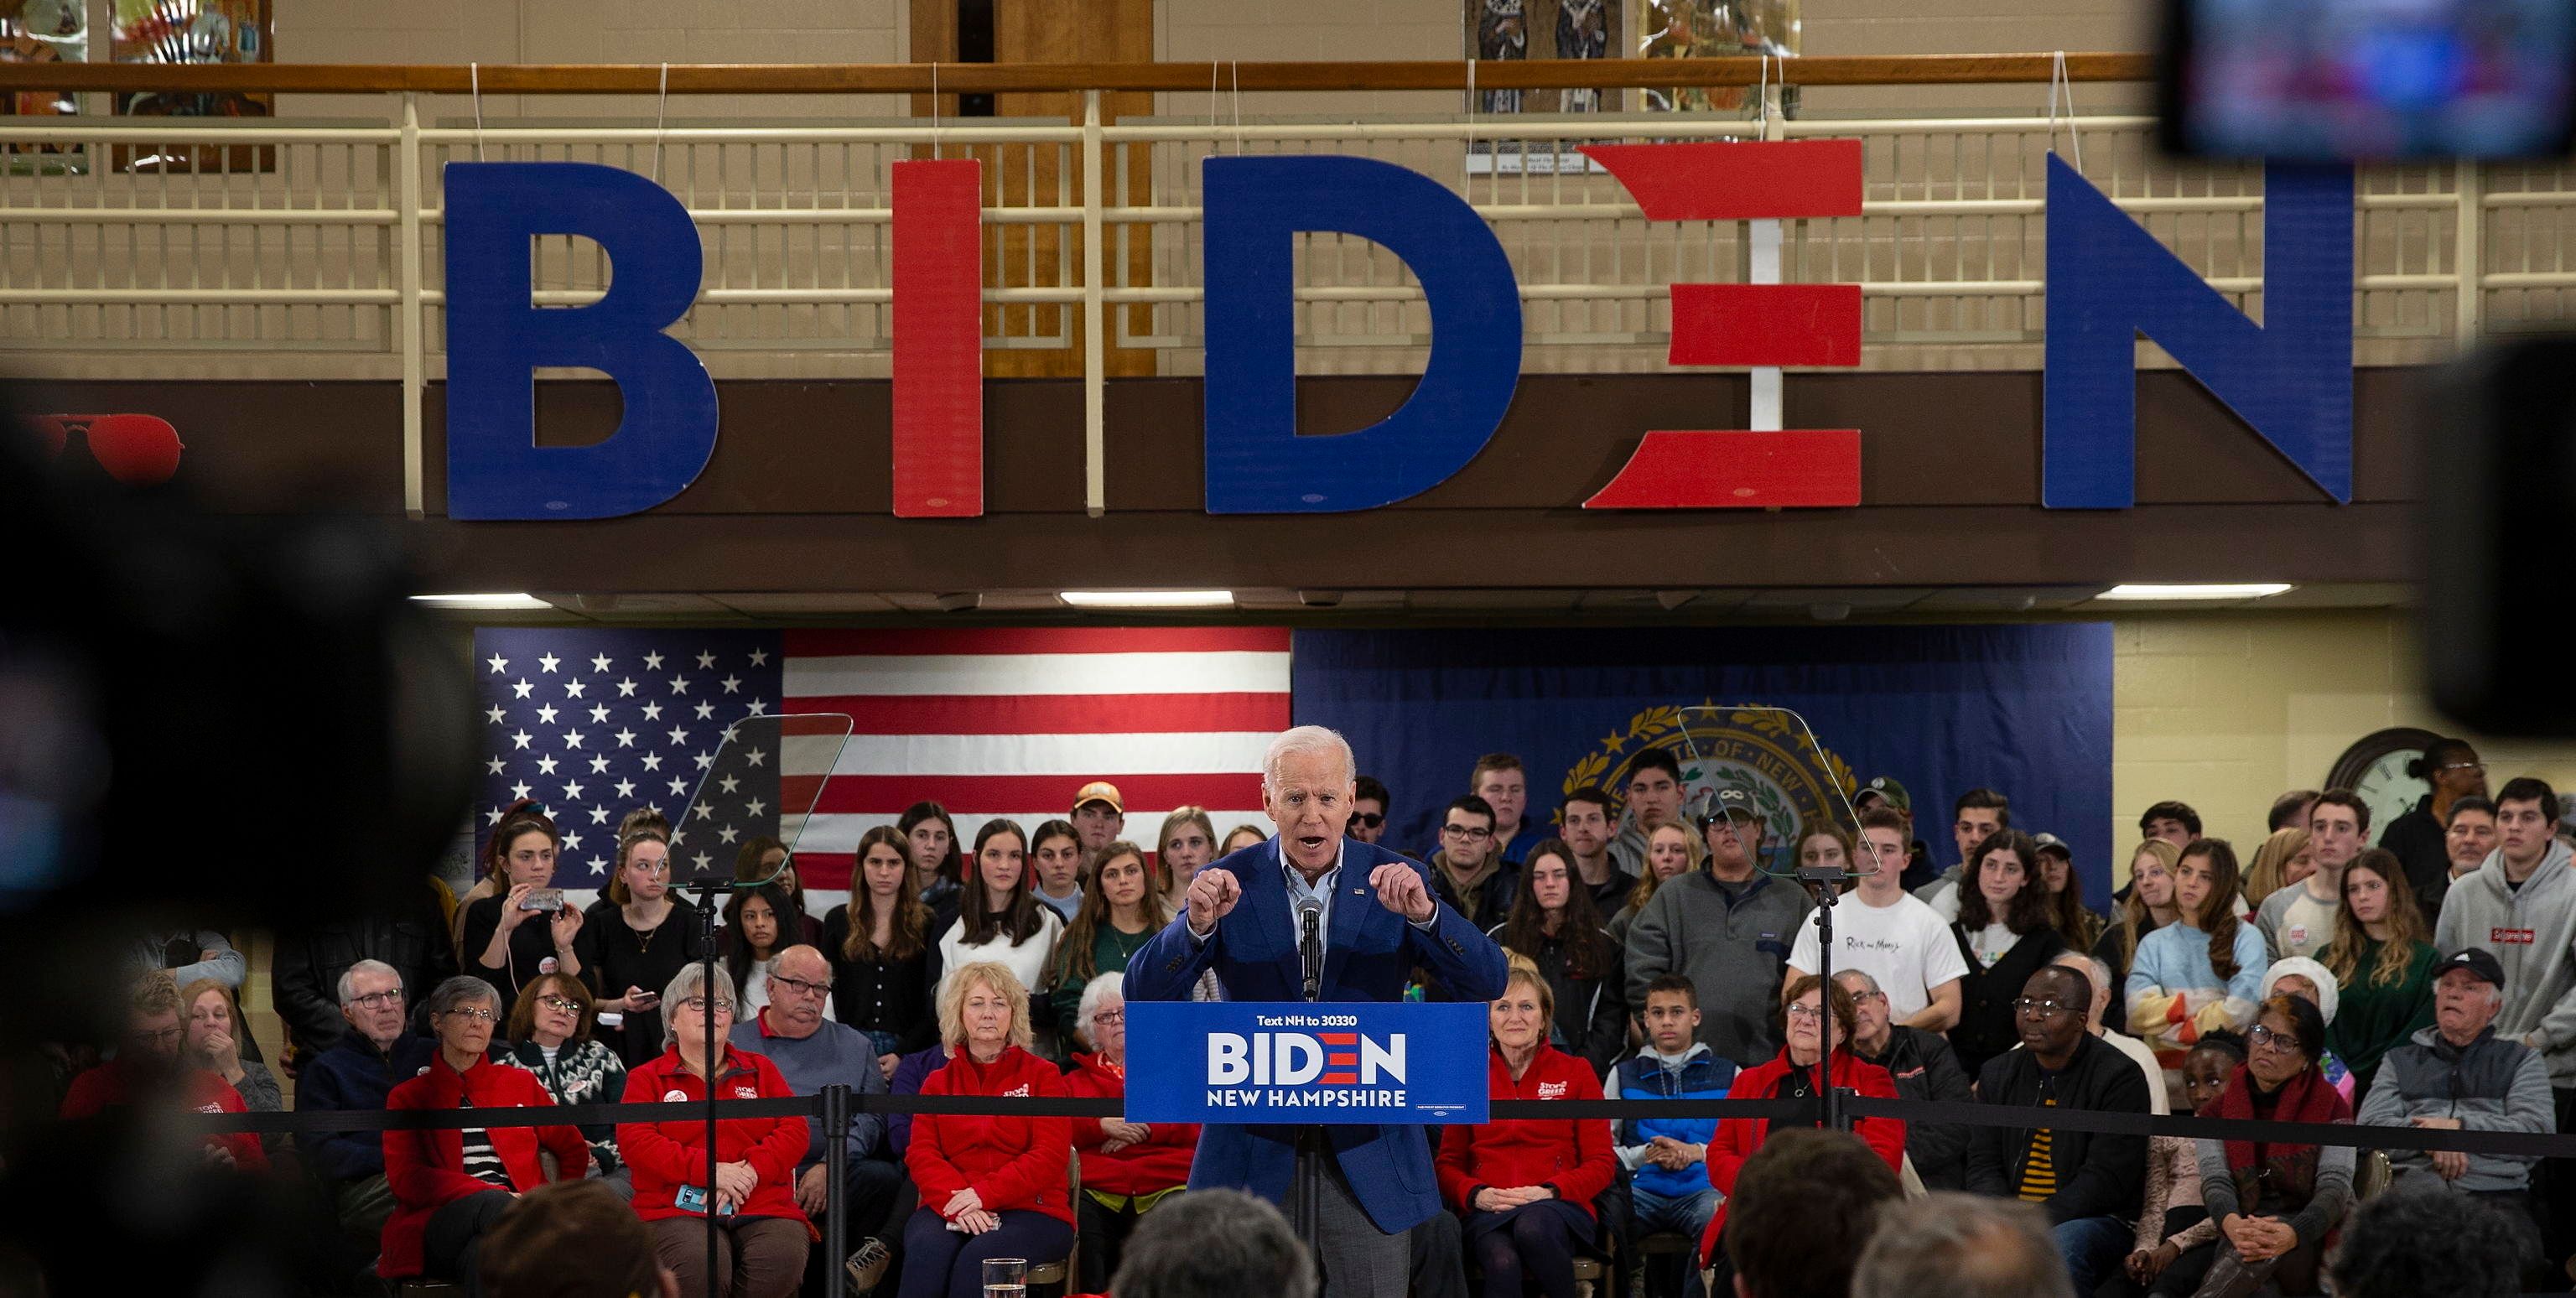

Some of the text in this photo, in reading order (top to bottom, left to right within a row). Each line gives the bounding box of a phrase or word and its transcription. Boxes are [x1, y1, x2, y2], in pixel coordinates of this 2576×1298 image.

[444, 138, 2355, 522] BIDEN
[1716, 740, 1742, 755] OF
[1757, 751, 1802, 792] NEW
[1257, 1015, 1358, 1026] Text NH to 30330
[1208, 1032, 1406, 1085] BIDEN
[1208, 1089, 1406, 1107] NEW HAMPSHIRE
